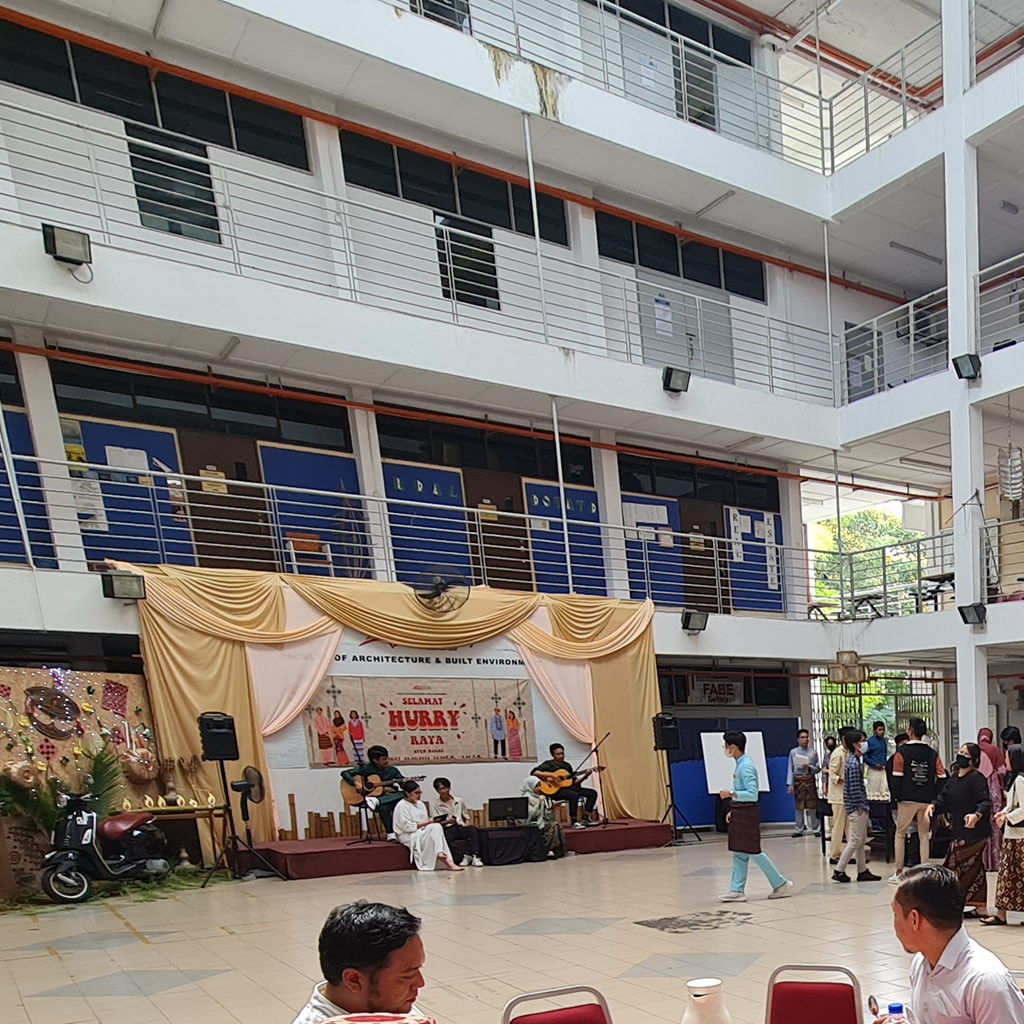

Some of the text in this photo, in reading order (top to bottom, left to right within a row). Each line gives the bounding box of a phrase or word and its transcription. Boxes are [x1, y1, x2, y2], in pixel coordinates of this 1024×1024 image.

[334, 654, 347, 662] OF
[352, 655, 431, 663] ARCHITECTURE
[445, 657, 472, 665] BUILT
[476, 658, 525, 666] ENVIRONM
[703, 683, 734, 695] FABE
[402, 697, 443, 706] SELAMAT
[388, 710, 460, 731] HURRY
[410, 735, 444, 745] RAYA
